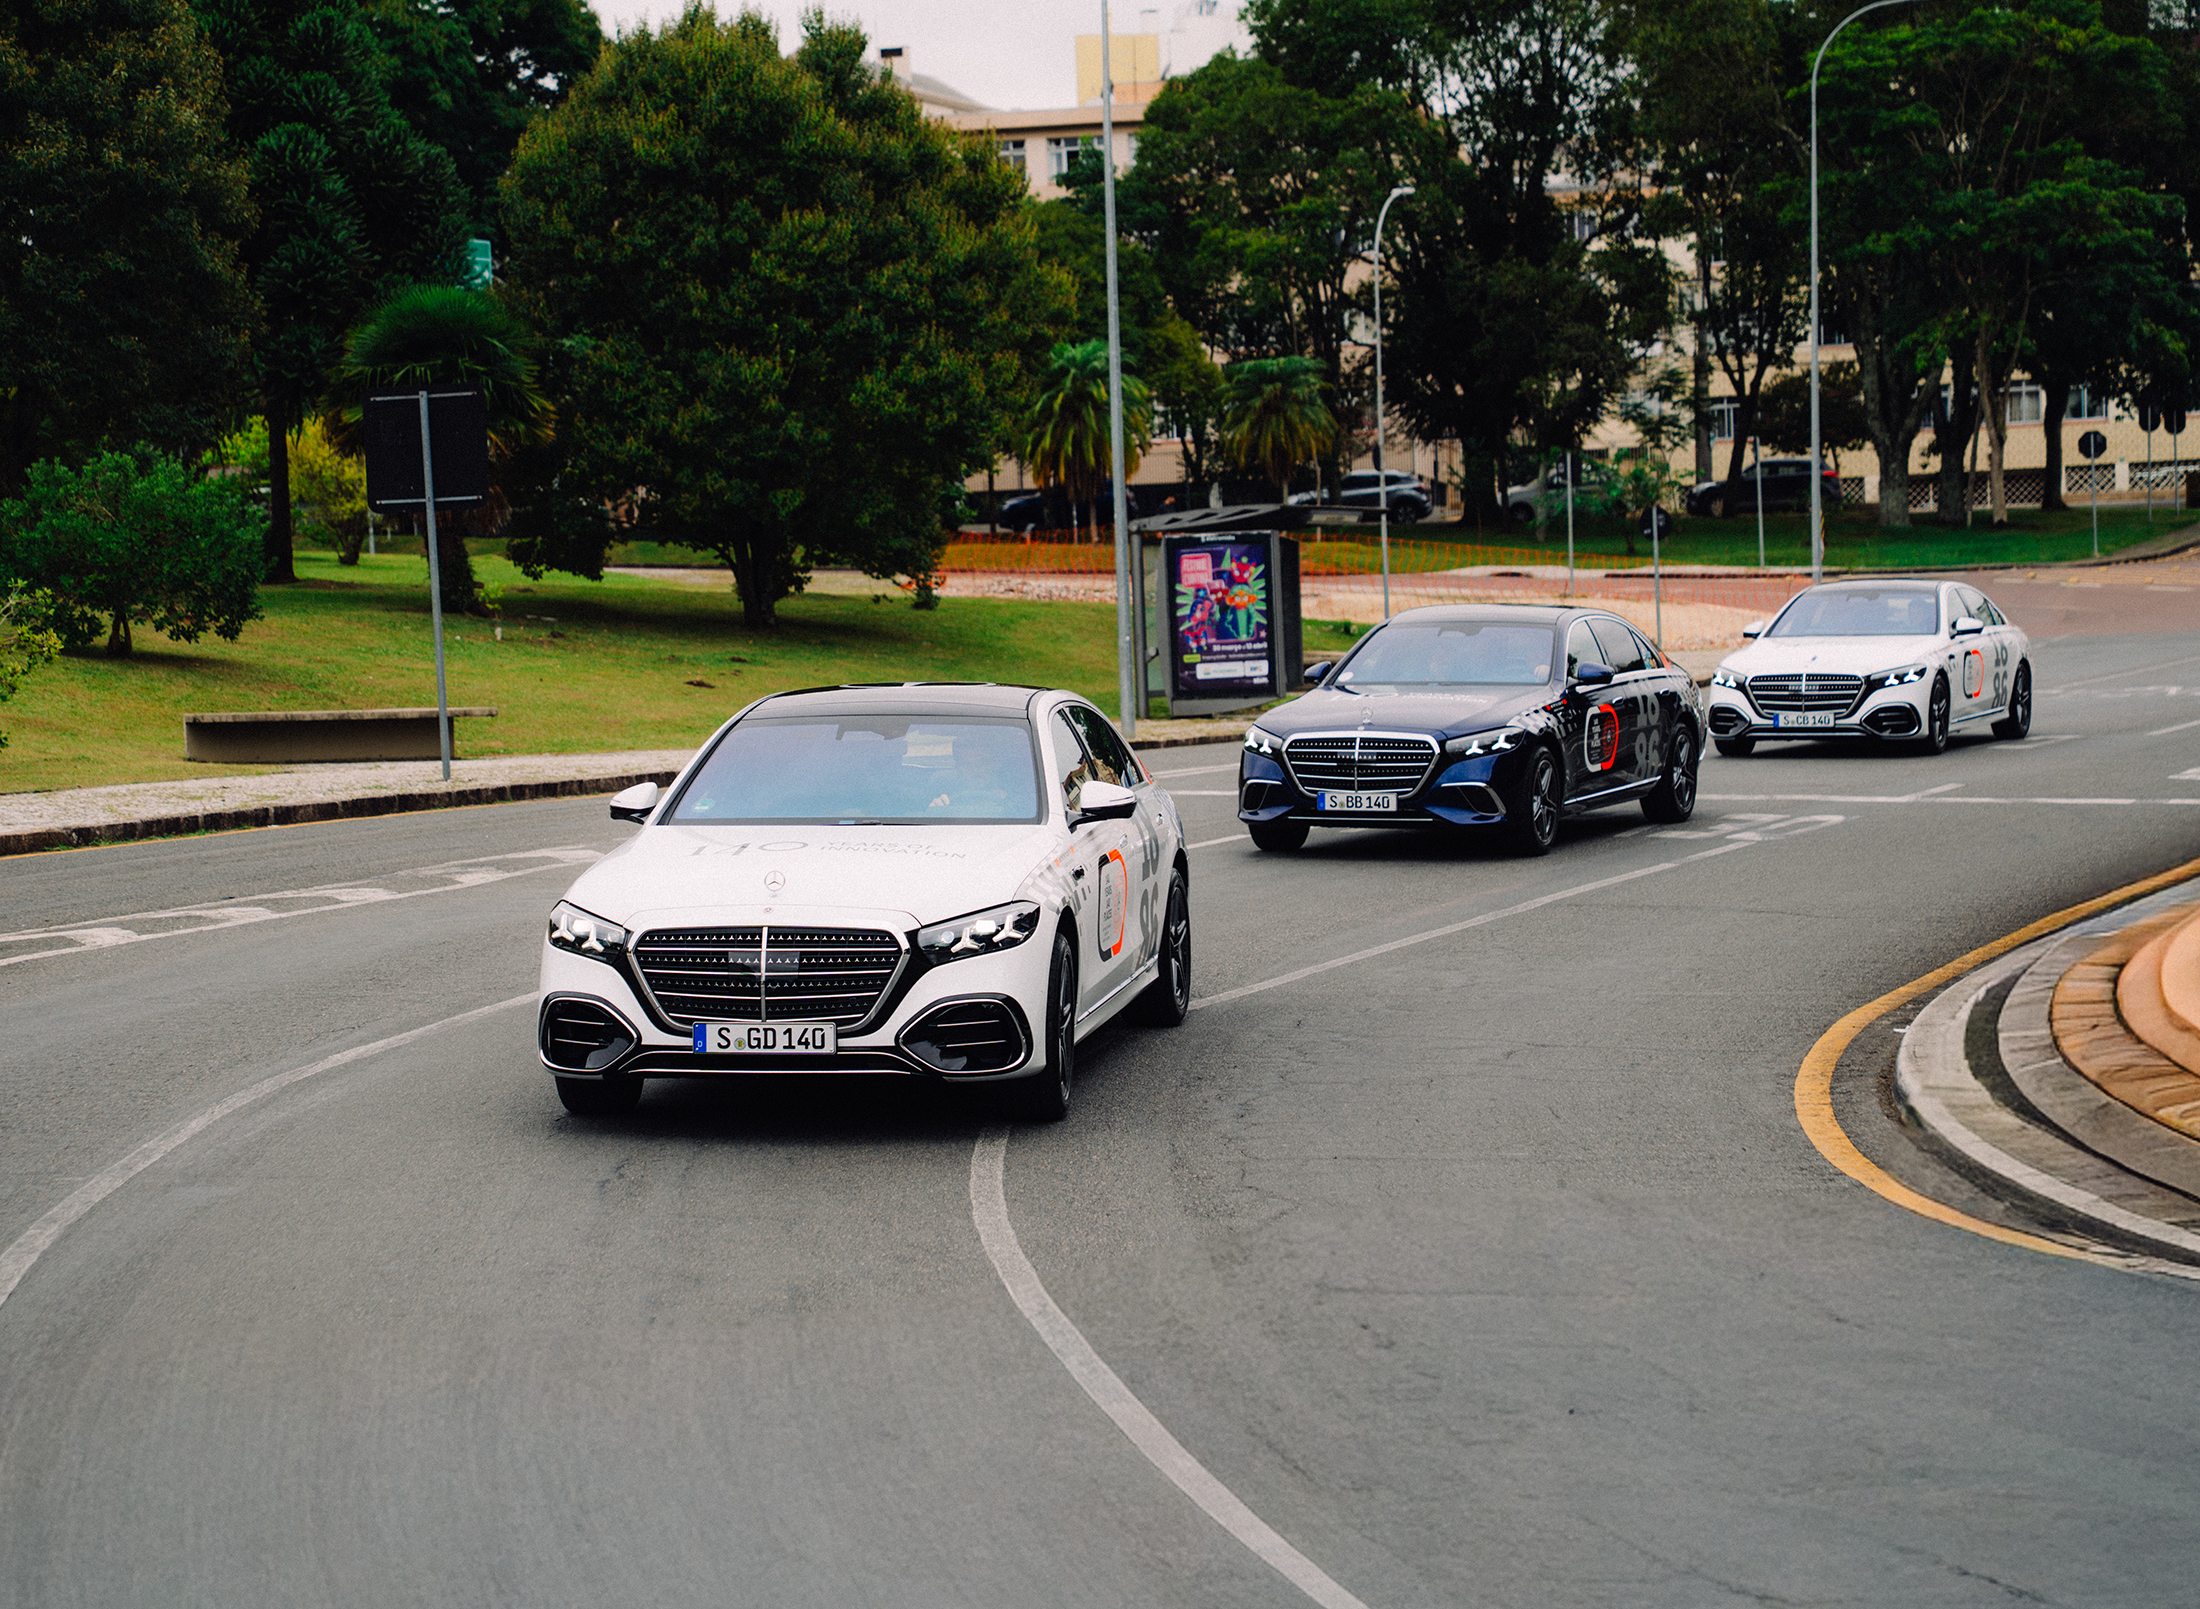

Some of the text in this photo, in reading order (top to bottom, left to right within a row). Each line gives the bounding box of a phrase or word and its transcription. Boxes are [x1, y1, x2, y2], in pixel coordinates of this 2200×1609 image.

[1992, 670, 2008, 709] 86
[1783, 715, 1790, 725] S
[1796, 715, 1810, 725] CB
[1811, 715, 1831, 725] 140
[1634, 729, 1661, 779] 86
[1329, 795, 1338, 808] S
[1346, 795, 1363, 809] BB
[1365, 796, 1390, 809] 140
[685, 841, 809, 857] 140
[820, 845, 967, 859] INNOVATION
[1136, 882, 1159, 972] 86
[717, 1026, 826, 1050] S GD 140
